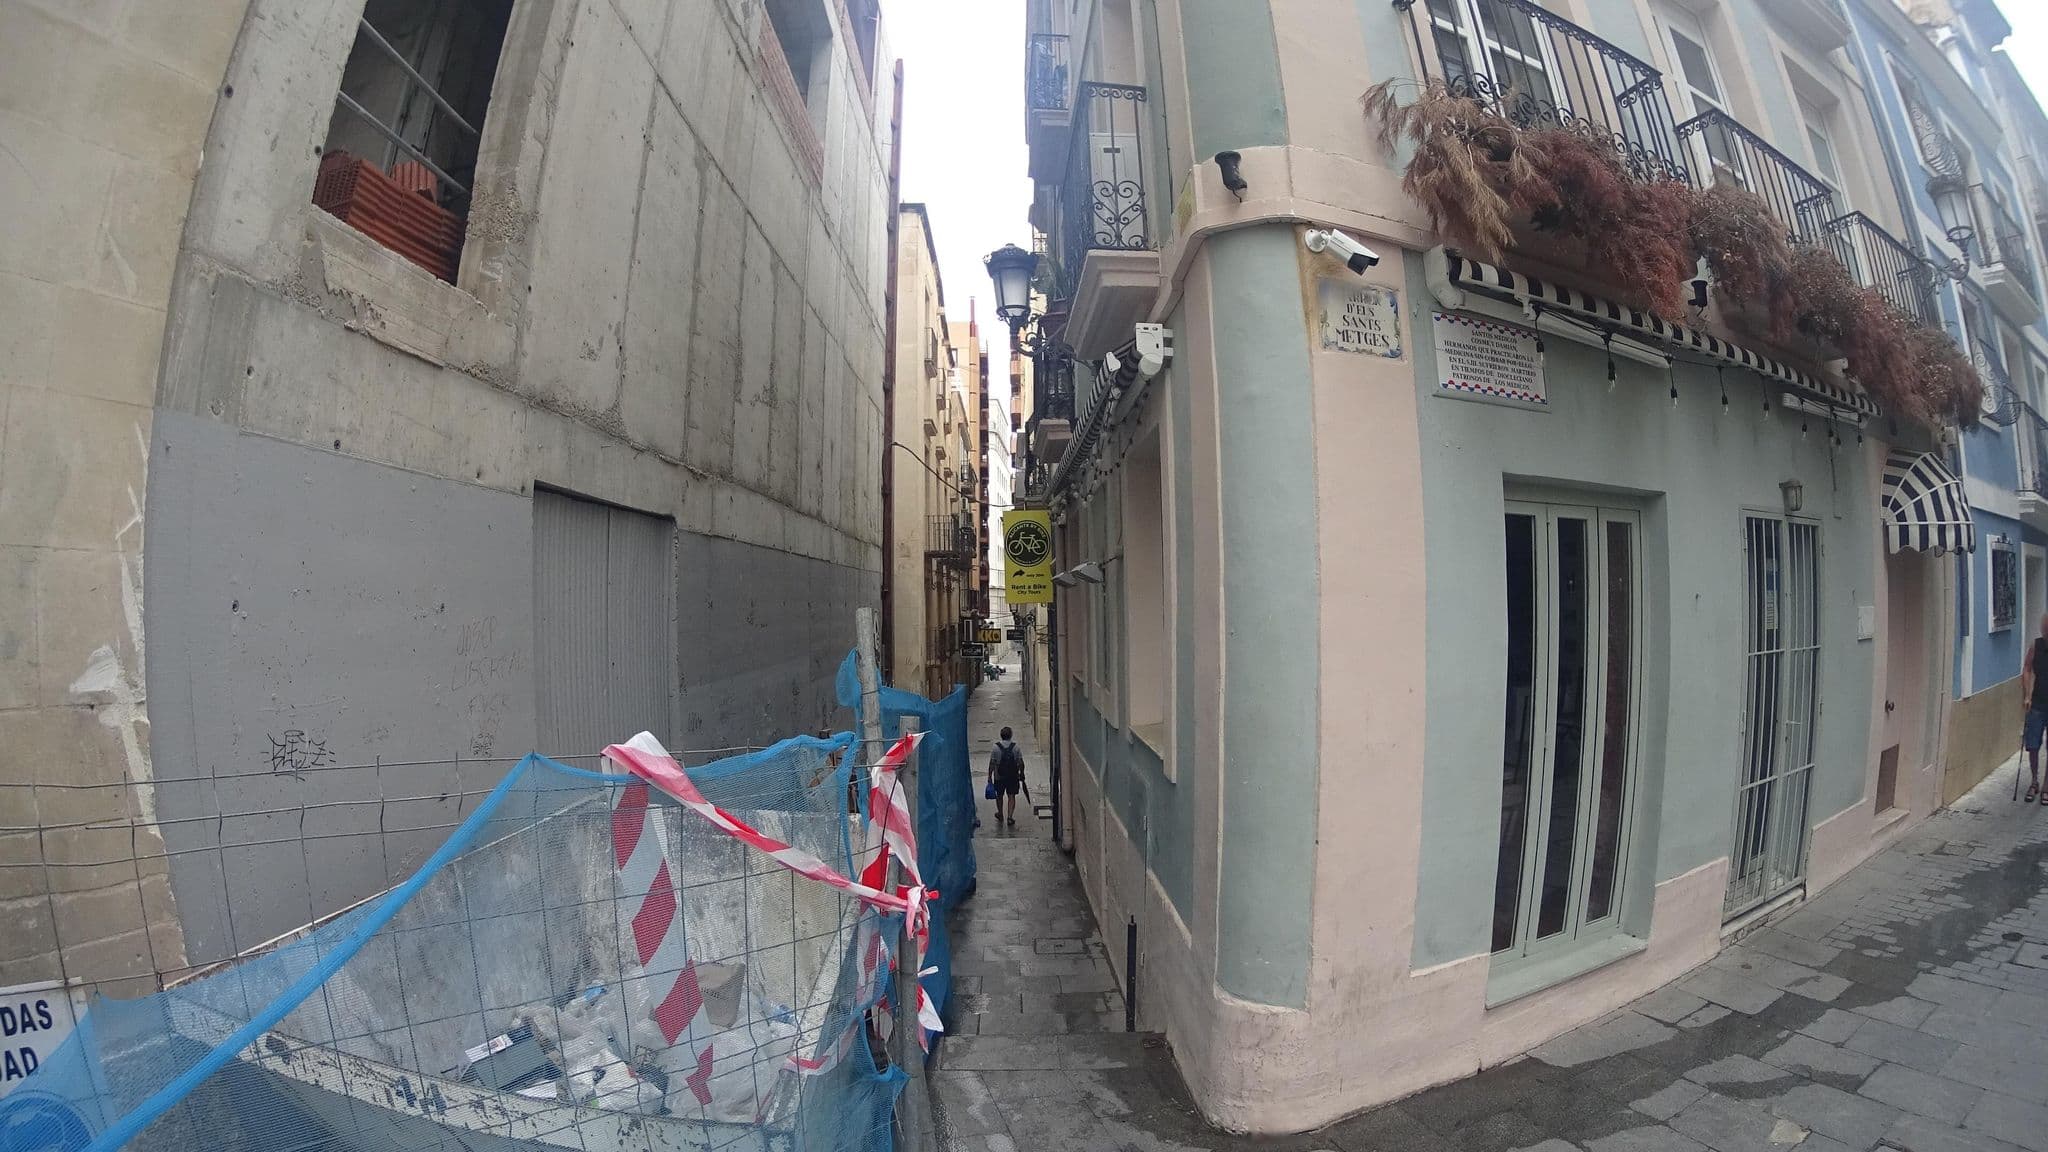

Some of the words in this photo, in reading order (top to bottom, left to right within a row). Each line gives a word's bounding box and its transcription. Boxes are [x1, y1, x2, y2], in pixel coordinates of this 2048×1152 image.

[1346, 303, 1375, 317] D'ELS
[1342, 314, 1381, 332] SANTS
[1335, 327, 1390, 348] METGES
[0, 1000, 53, 1037] DAS
[0, 1046, 39, 1082] AD
